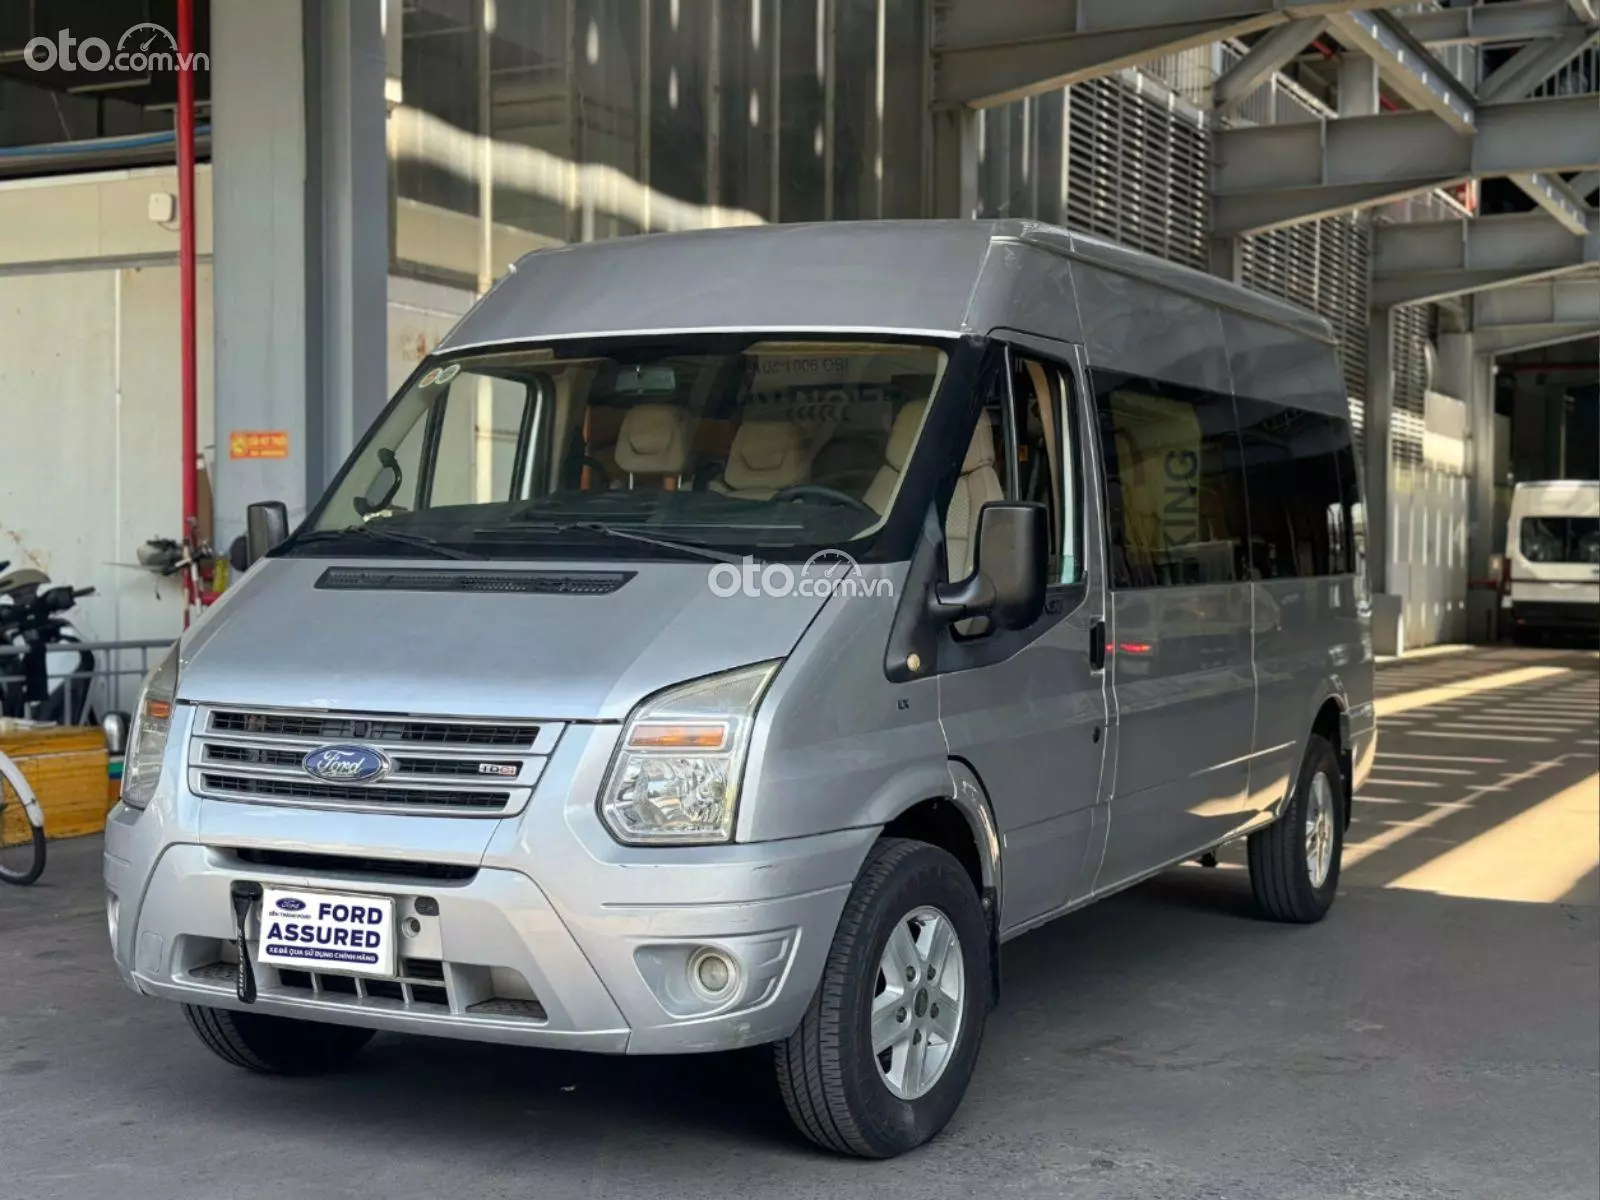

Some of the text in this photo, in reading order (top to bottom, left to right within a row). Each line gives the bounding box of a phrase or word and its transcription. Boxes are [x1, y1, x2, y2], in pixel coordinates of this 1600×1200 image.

[316, 749, 366, 775] Ford
[317, 902, 384, 926] FORD
[266, 921, 382, 949] ASSURED
[289, 947, 303, 957] QUA
